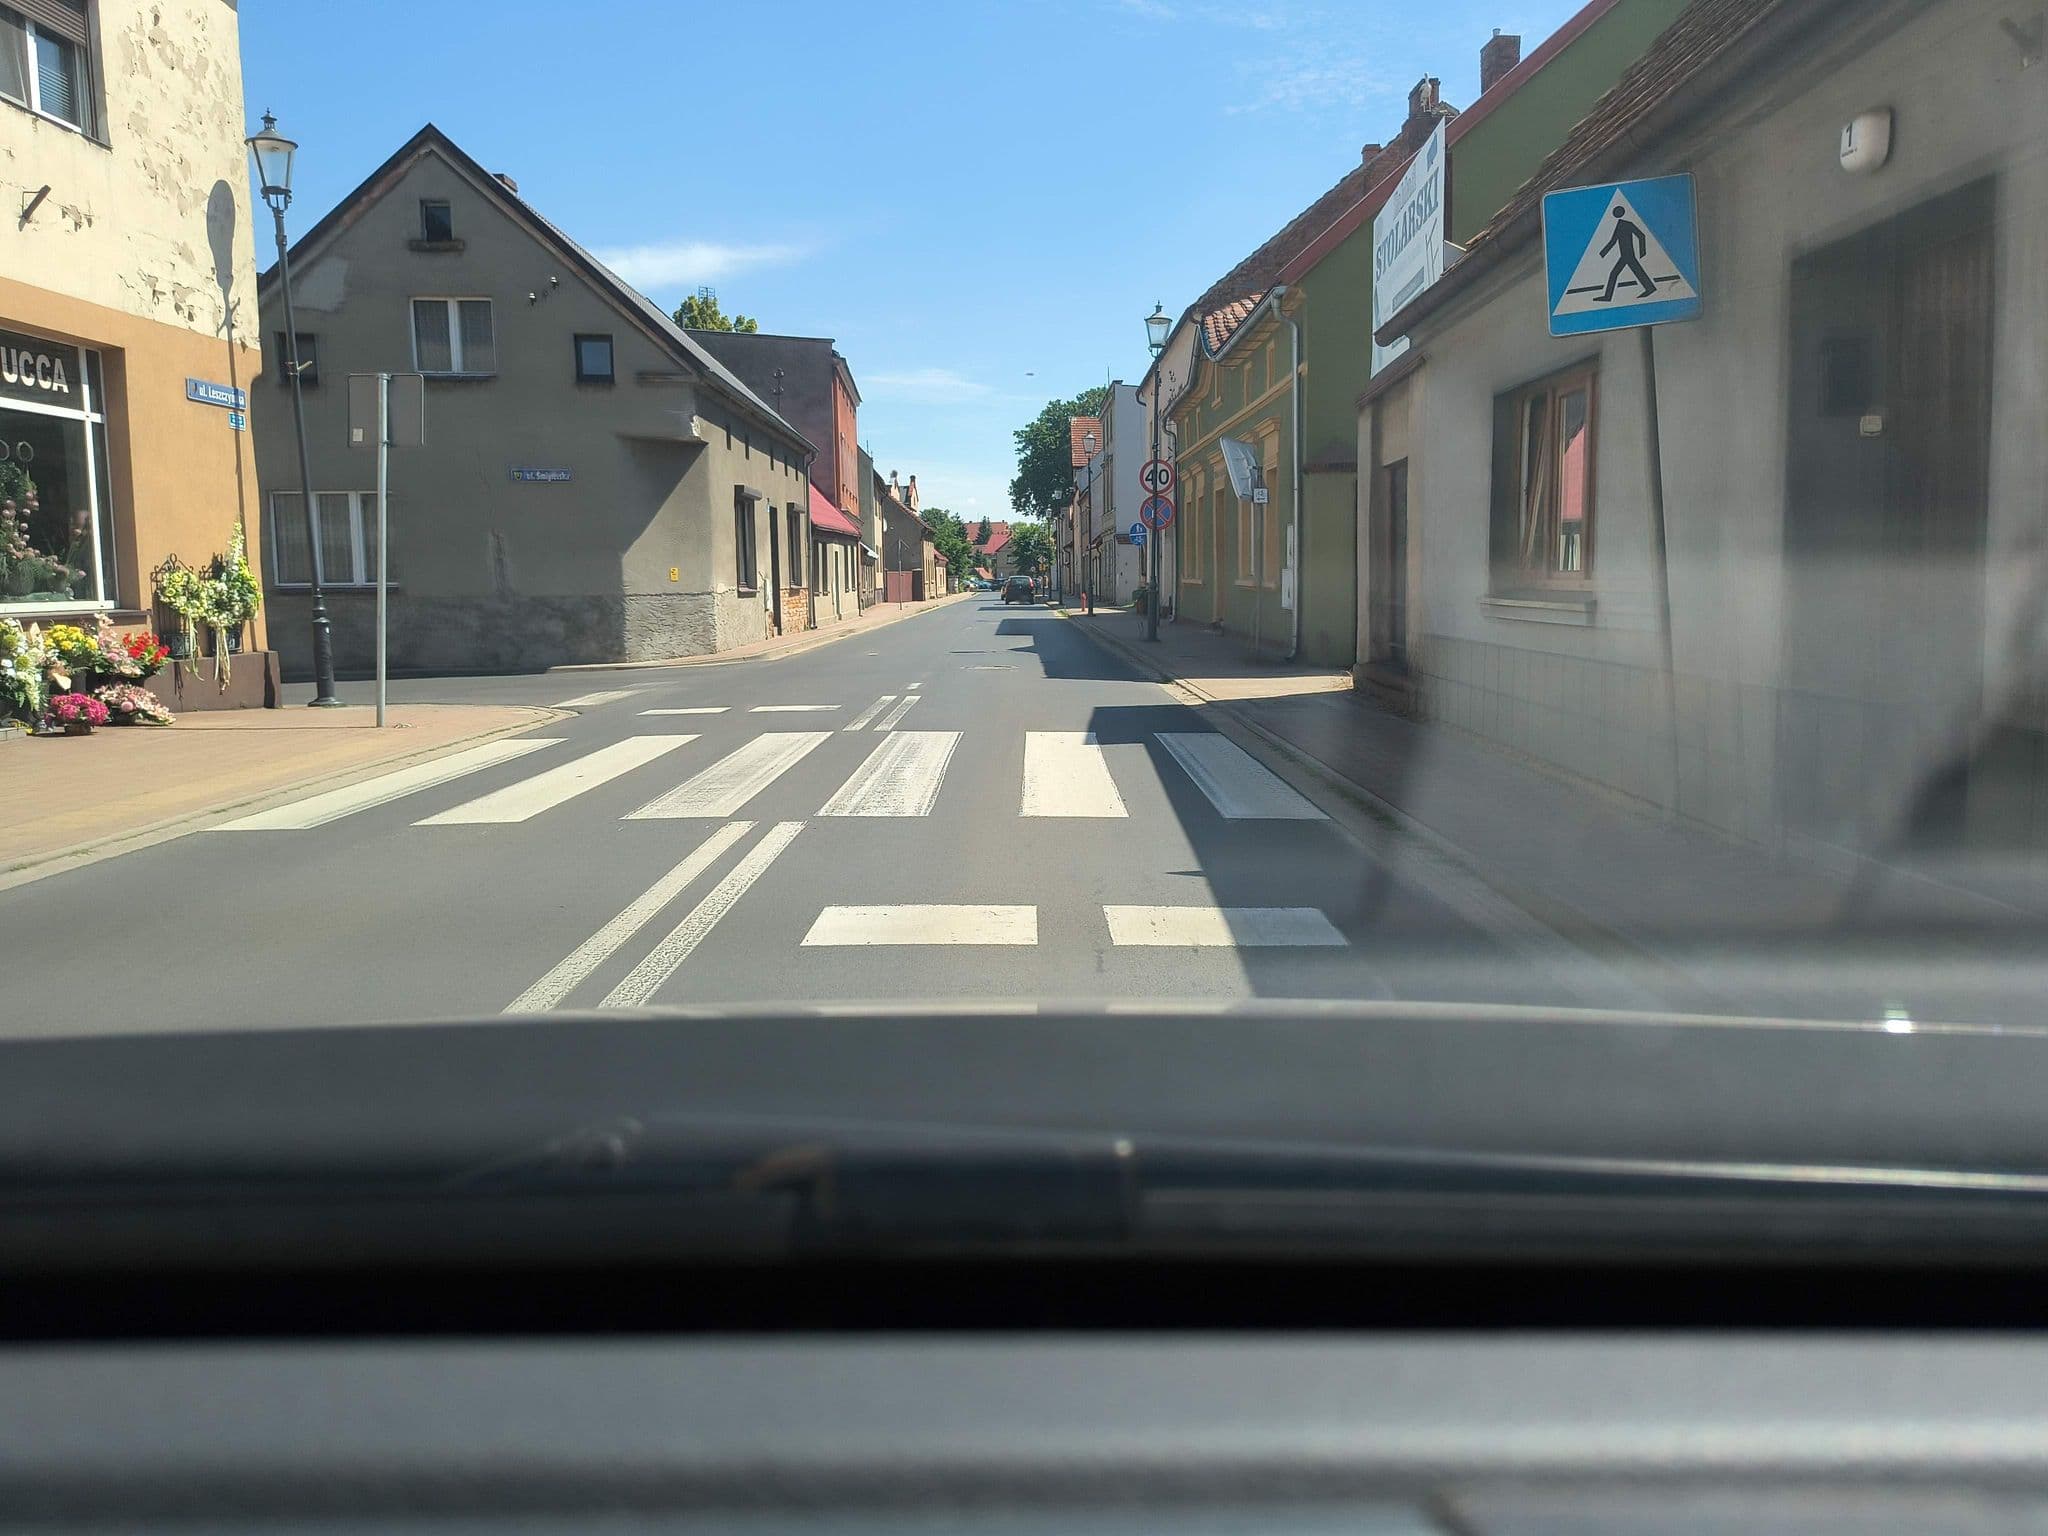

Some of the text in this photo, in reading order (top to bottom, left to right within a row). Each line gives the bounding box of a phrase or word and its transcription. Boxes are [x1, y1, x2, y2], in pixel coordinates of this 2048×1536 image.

[1846, 122, 1853, 147] 1
[1376, 166, 1440, 283] STOLARSKI
[0, 346, 69, 393] UCCA
[208, 386, 245, 405] Leszczyńa
[1145, 469, 1170, 485] 40
